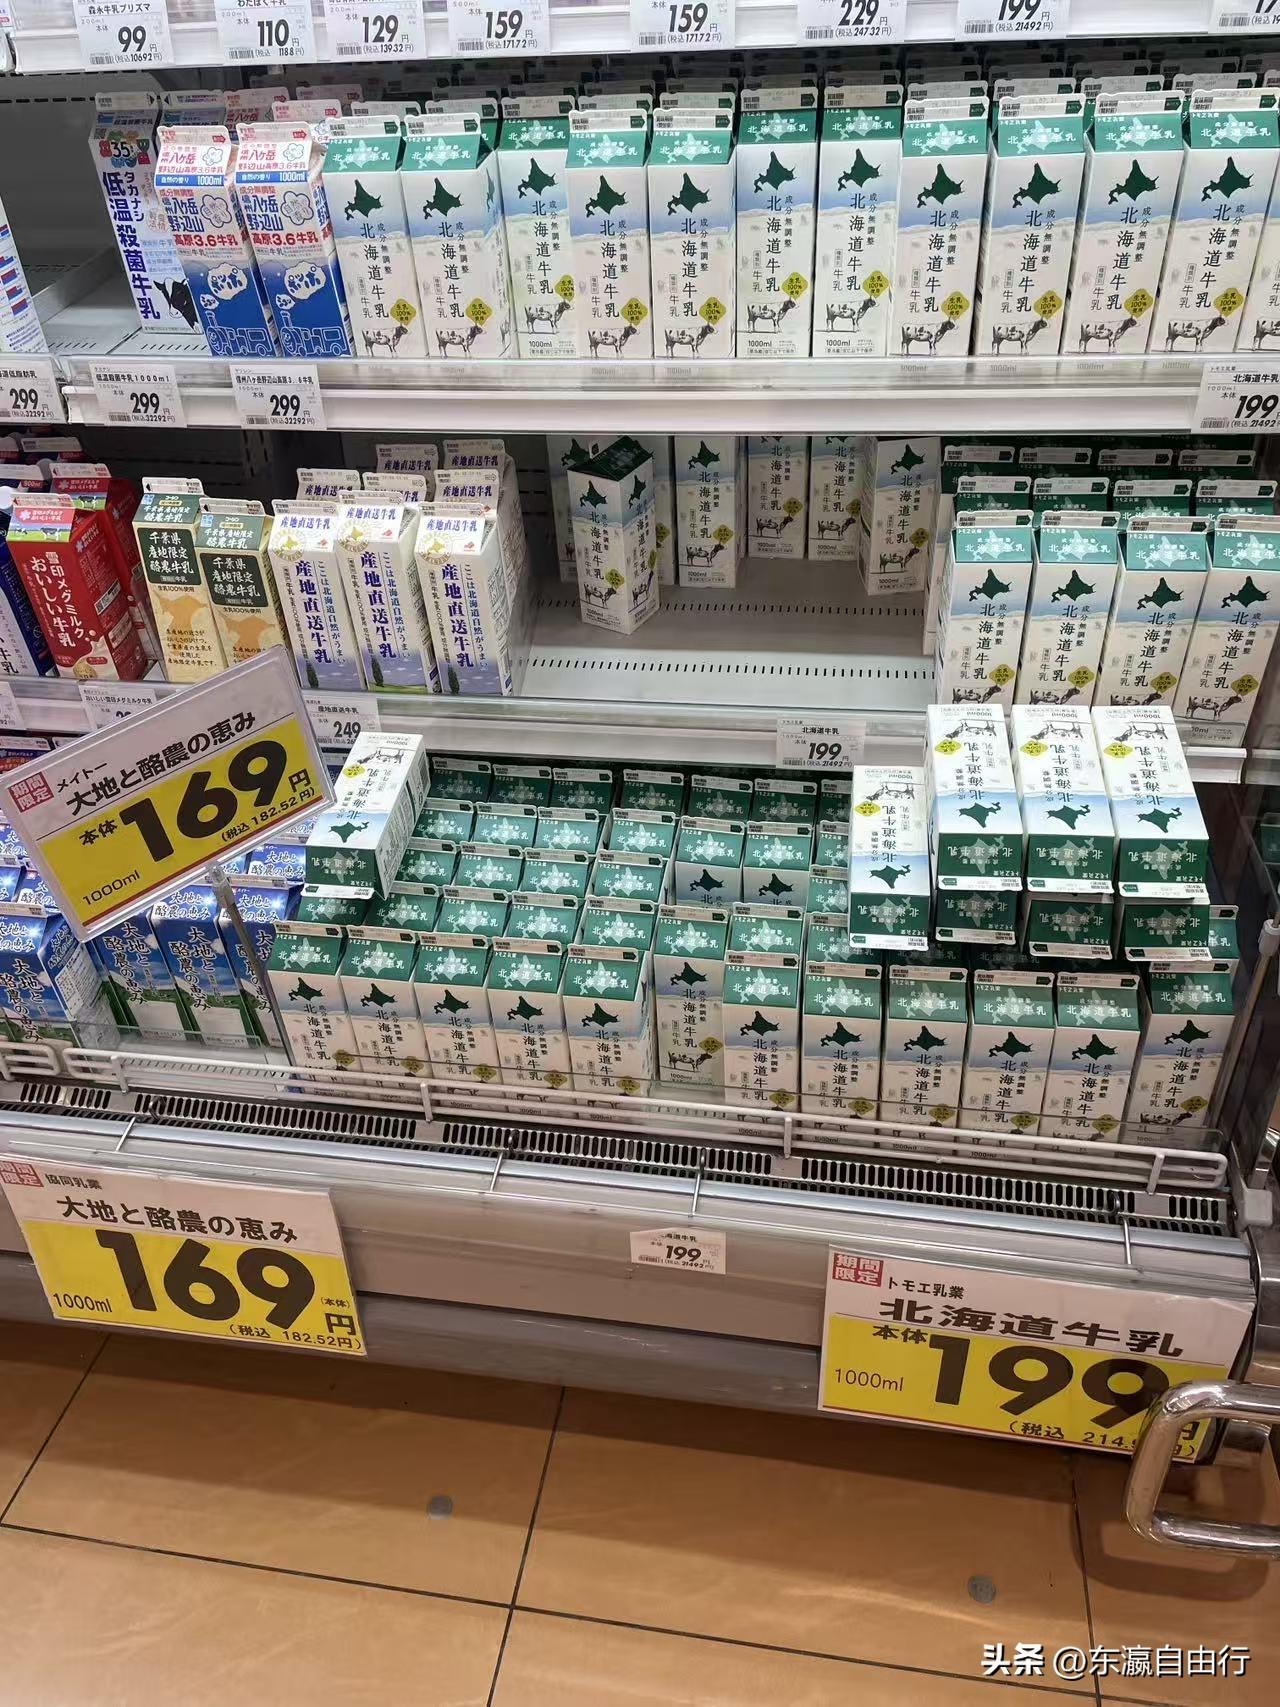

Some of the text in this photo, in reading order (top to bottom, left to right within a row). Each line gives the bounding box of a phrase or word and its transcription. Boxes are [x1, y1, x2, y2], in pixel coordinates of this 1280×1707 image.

[486, 9, 523, 39] 159
[669, 3, 708, 32] 159
[838, 0, 880, 26] 229
[999, 0, 1040, 20] 199
[118, 26, 147, 53] 99
[258, 20, 289, 47] 110
[362, 14, 398, 43] 129
[197, 176, 223, 186] 1000ml
[278, 172, 306, 182] 1000ml
[124, 172, 145, 222] タカナシ
[169, 215, 205, 233] 野辺山
[245, 214, 283, 231] 野辺山
[103, 172, 161, 321] 低温殺菌牛乳
[173, 234, 239, 247] 高原3.6牛乳
[250, 231, 319, 245] 高原3.6牛乳
[532, 200, 554, 295] 北海道牛乳
[766, 195, 782, 293] 北海道牛乳
[847, 194, 866, 291] 北海道牛乳
[360, 222, 389, 319] 北海道牛乳
[438, 221, 465, 319] 北海道牛乳
[600, 220, 620, 318] 北海道牛乳
[682, 219, 698, 318] 北海道牛乳
[924, 211, 947, 313] 北海道牛乳
[1017, 210, 1043, 313] 北海道牛乳
[1106, 207, 1139, 311] 北海道牛乳
[1195, 204, 1230, 309] 北海道牛乳
[1233, 374, 1280, 384] 北海道牛乳
[10, 388, 38, 410] 299
[130, 392, 160, 414] 299
[270, 394, 300, 416] 299
[1235, 395, 1279, 419] 199
[451, 456, 499, 466] 産地直送牛乳
[442, 485, 493, 498] 産地直送牛乳
[769, 446, 783, 512] 北海道牛乳
[832, 446, 848, 513] 北海道牛乳
[143, 513, 183, 523] 酪農牛乳
[346, 507, 396, 520] 産地直送牛乳
[699, 472, 712, 540] 北海道牛乳
[896, 475, 913, 545] 北海道牛乳
[149, 532, 181, 545] 千葉県
[280, 518, 331, 530] 産地直送牛乳
[426, 518, 478, 532] 産地直送牛乳
[148, 546, 189, 560] 産地限定
[206, 537, 248, 549] 酪農牛乳
[589, 512, 604, 581] 北海道牛乳
[150, 560, 194, 574] 酪農牛乳
[212, 570, 254, 583] 産地限定
[213, 557, 247, 570] 千葉県
[31, 556, 76, 648] おいしい牛乳
[46, 551, 85, 639] 雪印メグミルク
[158, 585, 195, 593] 生乳100%使用
[214, 583, 261, 598] 酪農牛乳
[295, 560, 332, 665] 産地直送牛乳
[360, 551, 397, 659] 産地直送牛乳
[441, 563, 474, 668] 産地直送牛乳
[973, 603, 996, 680] 北海道牛乳
[1052, 604, 1078, 682] 北海道牛乳
[1135, 612, 1165, 688] 北海道牛乳
[1213, 611, 1250, 690] 北海道牛乳
[333, 721, 361, 738] 249
[802, 726, 839, 735] 北海道牛乳
[66, 711, 256, 816] 大地と酪農の恵み
[808, 743, 842, 761] 199
[57, 762, 108, 793] メイトー
[79, 740, 312, 862] 本体 169 円
[82, 869, 140, 906] 1000ml
[171, 891, 203, 905] 大地と
[154, 904, 211, 919] 酪農の恵み
[122, 923, 150, 964] 大地と
[187, 927, 216, 970] 大地と
[278, 949, 331, 963] 北海道牛乳
[103, 937, 146, 1004] 酪農の恵み
[351, 956, 405, 968] 北海道牛乳
[424, 963, 479, 975] 北海道牛乳
[497, 969, 553, 982] 北海道牛乳
[169, 943, 211, 1012] 酪農の恵み
[573, 976, 629, 988] 北海道牛乳
[732, 985, 792, 997] 北海道牛乳
[813, 994, 874, 1007] 北海道牛乳
[983, 1003, 1047, 1016] 北海道牛乳
[1160, 990, 1226, 1004] 北海道牛乳
[304, 1004, 331, 1063] 北海道牛乳
[683, 988, 698, 1049] 北海道牛乳
[376, 1010, 400, 1068] 北海道牛乳
[449, 1016, 472, 1075] 北海道牛乳
[521, 1023, 543, 1083] 北海道牛乳
[596, 1030, 616, 1089] 北海道牛乳
[753, 1039, 768, 1102] 北海道牛乳
[831, 1049, 849, 1109] 北海道牛乳
[912, 1053, 932, 1116] 北海道牛乳
[994, 1059, 1017, 1125] 北海道牛乳
[1164, 1046, 1193, 1110] 北海道牛乳
[1075, 1062, 1101, 1130] 北海道牛乳
[57, 1196, 298, 1243] 大地と酪農の恵み
[666, 1245, 701, 1261] 199
[835, 1254, 880, 1270] 期間
[95, 1229, 357, 1336] 169 円
[834, 1269, 880, 1286] 限定
[887, 1277, 965, 1299] トモエ乳業
[53, 1292, 112, 1313] 1000ml
[878, 1298, 1184, 1356] 北海道牛乳
[834, 1368, 904, 1392] 1000ml
[872, 1325, 929, 1344] 本体
[928, 1334, 1170, 1429] 199
